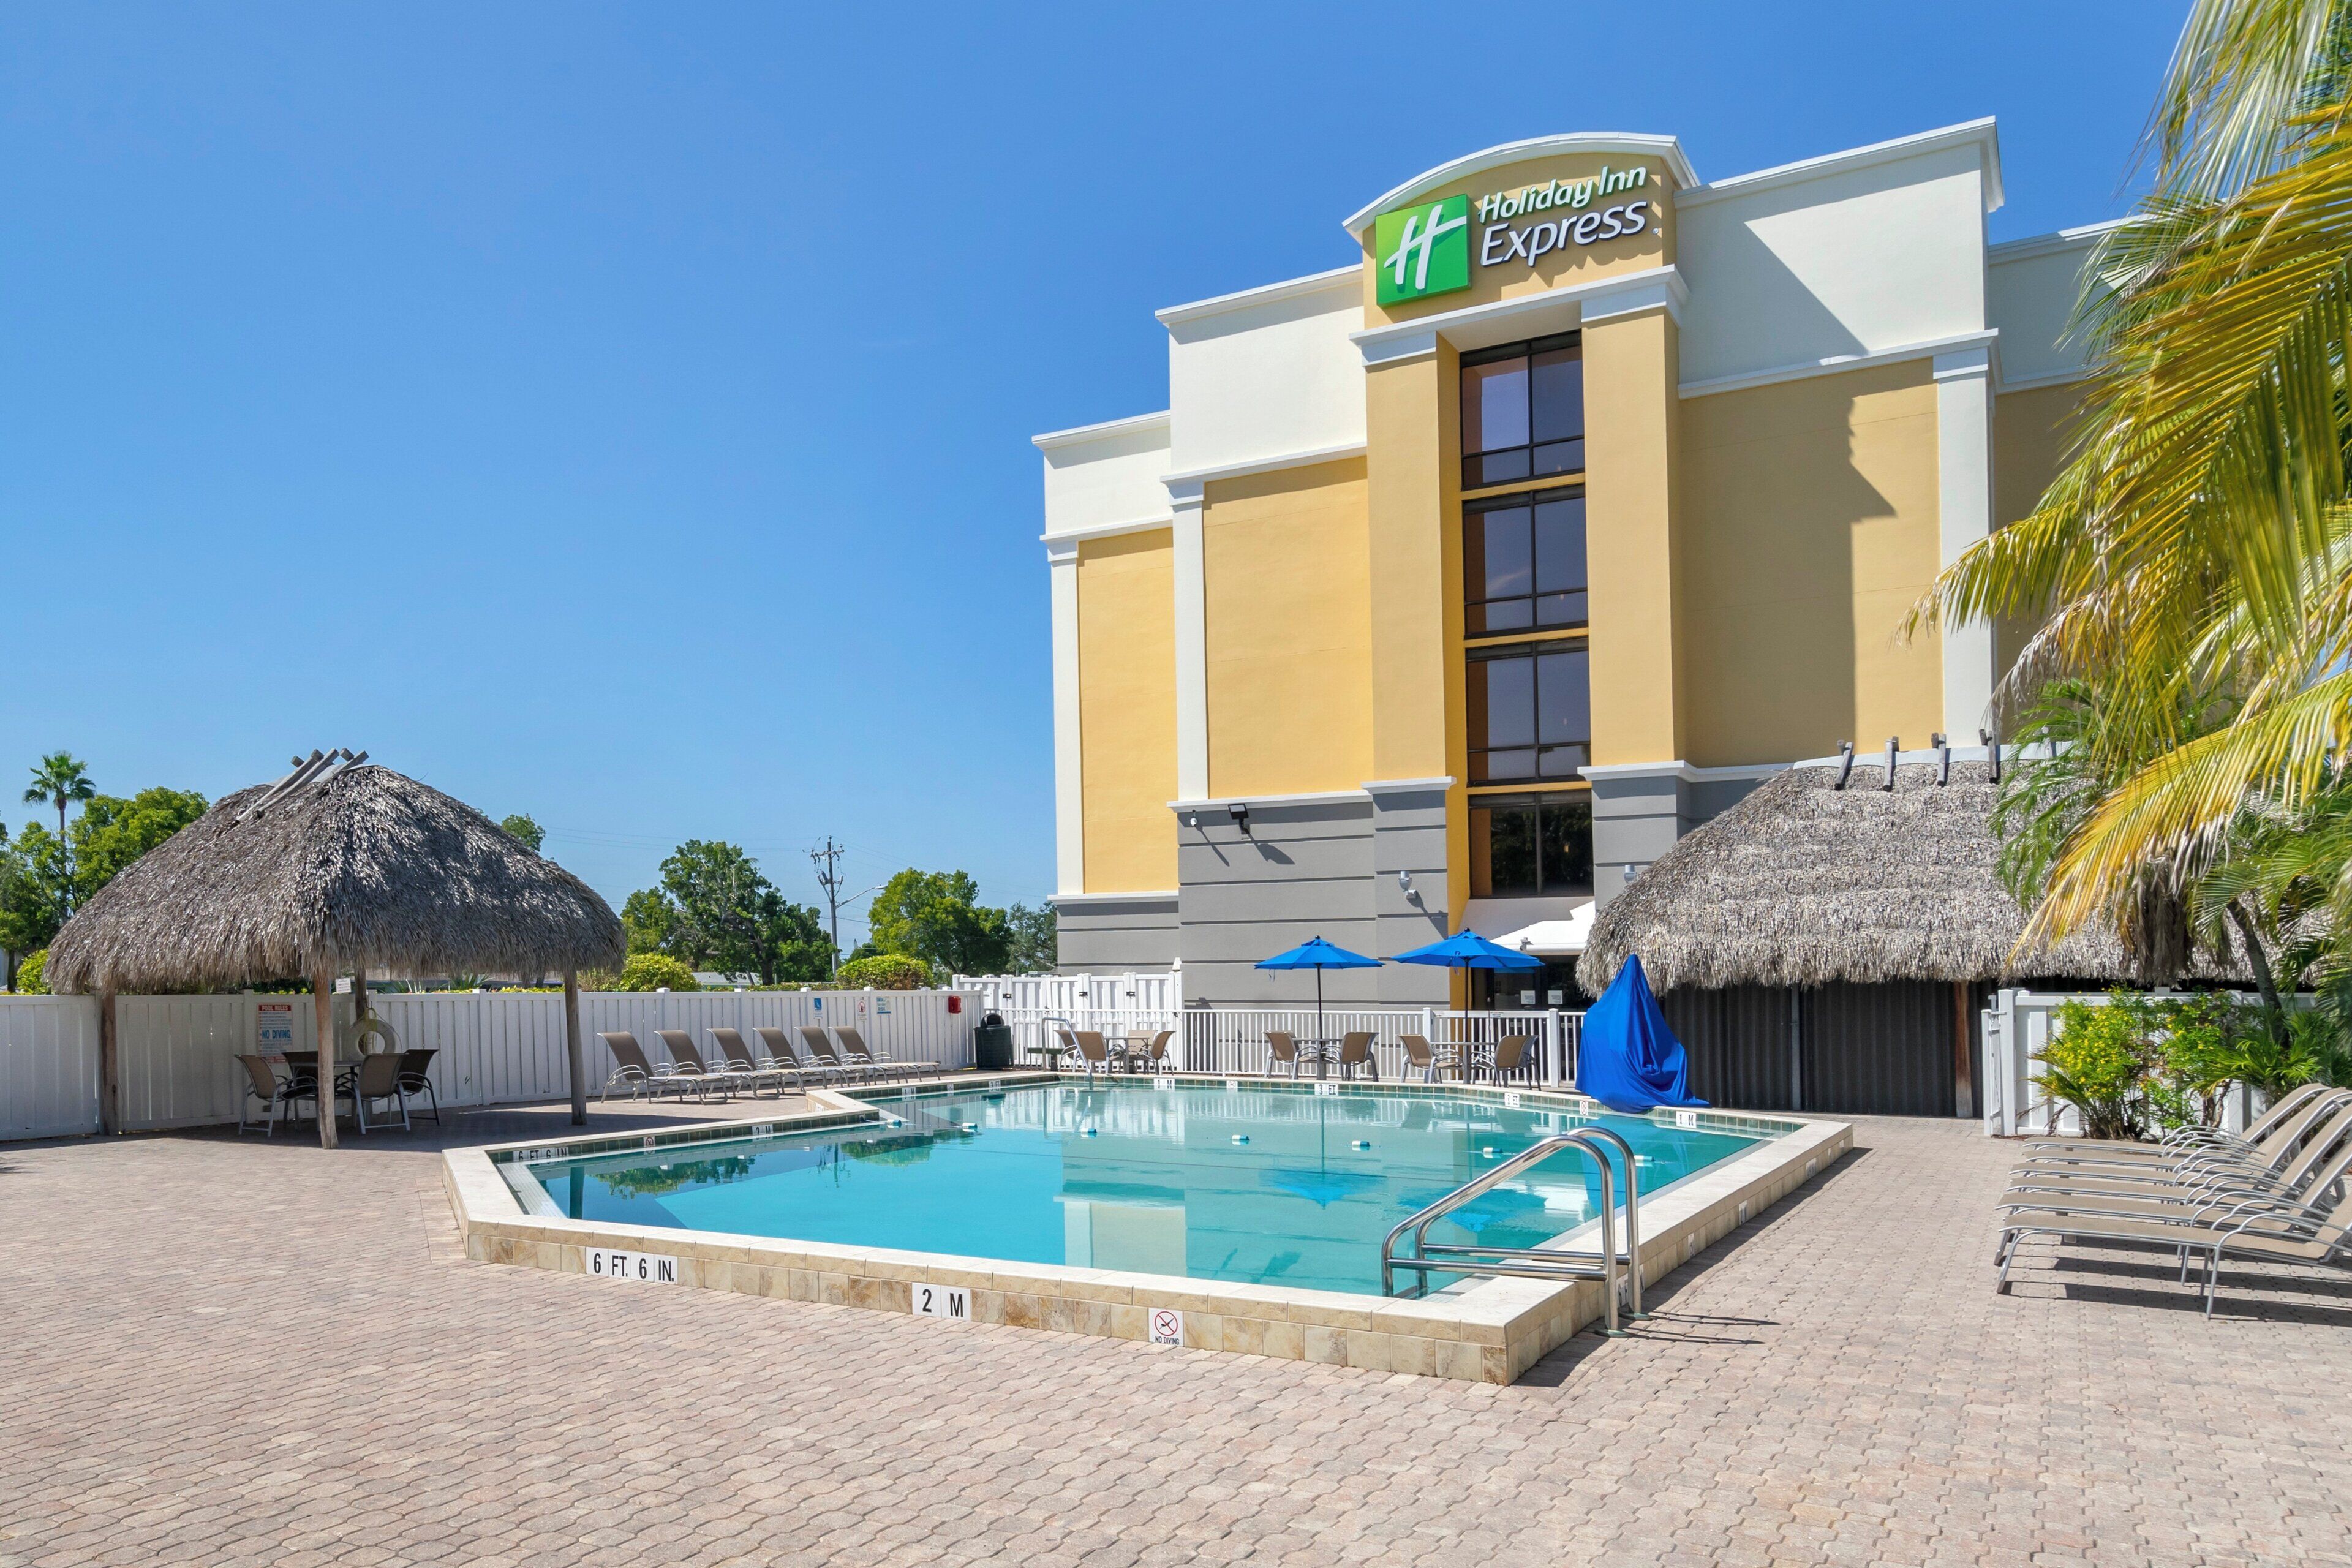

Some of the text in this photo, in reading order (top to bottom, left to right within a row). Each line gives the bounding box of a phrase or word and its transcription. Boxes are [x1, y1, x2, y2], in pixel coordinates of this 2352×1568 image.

[1477, 165, 1647, 224] Holiday Inn
[1384, 204, 1467, 290] H
[1480, 201, 1648, 267] Express
[262, 1030, 270, 1039] NO
[518, 1151, 524, 1161] 6
[557, 1148, 567, 1157] IN
[593, 1253, 674, 1282] 6 FT. 6 IN.
[922, 1289, 963, 1317] 2 M
